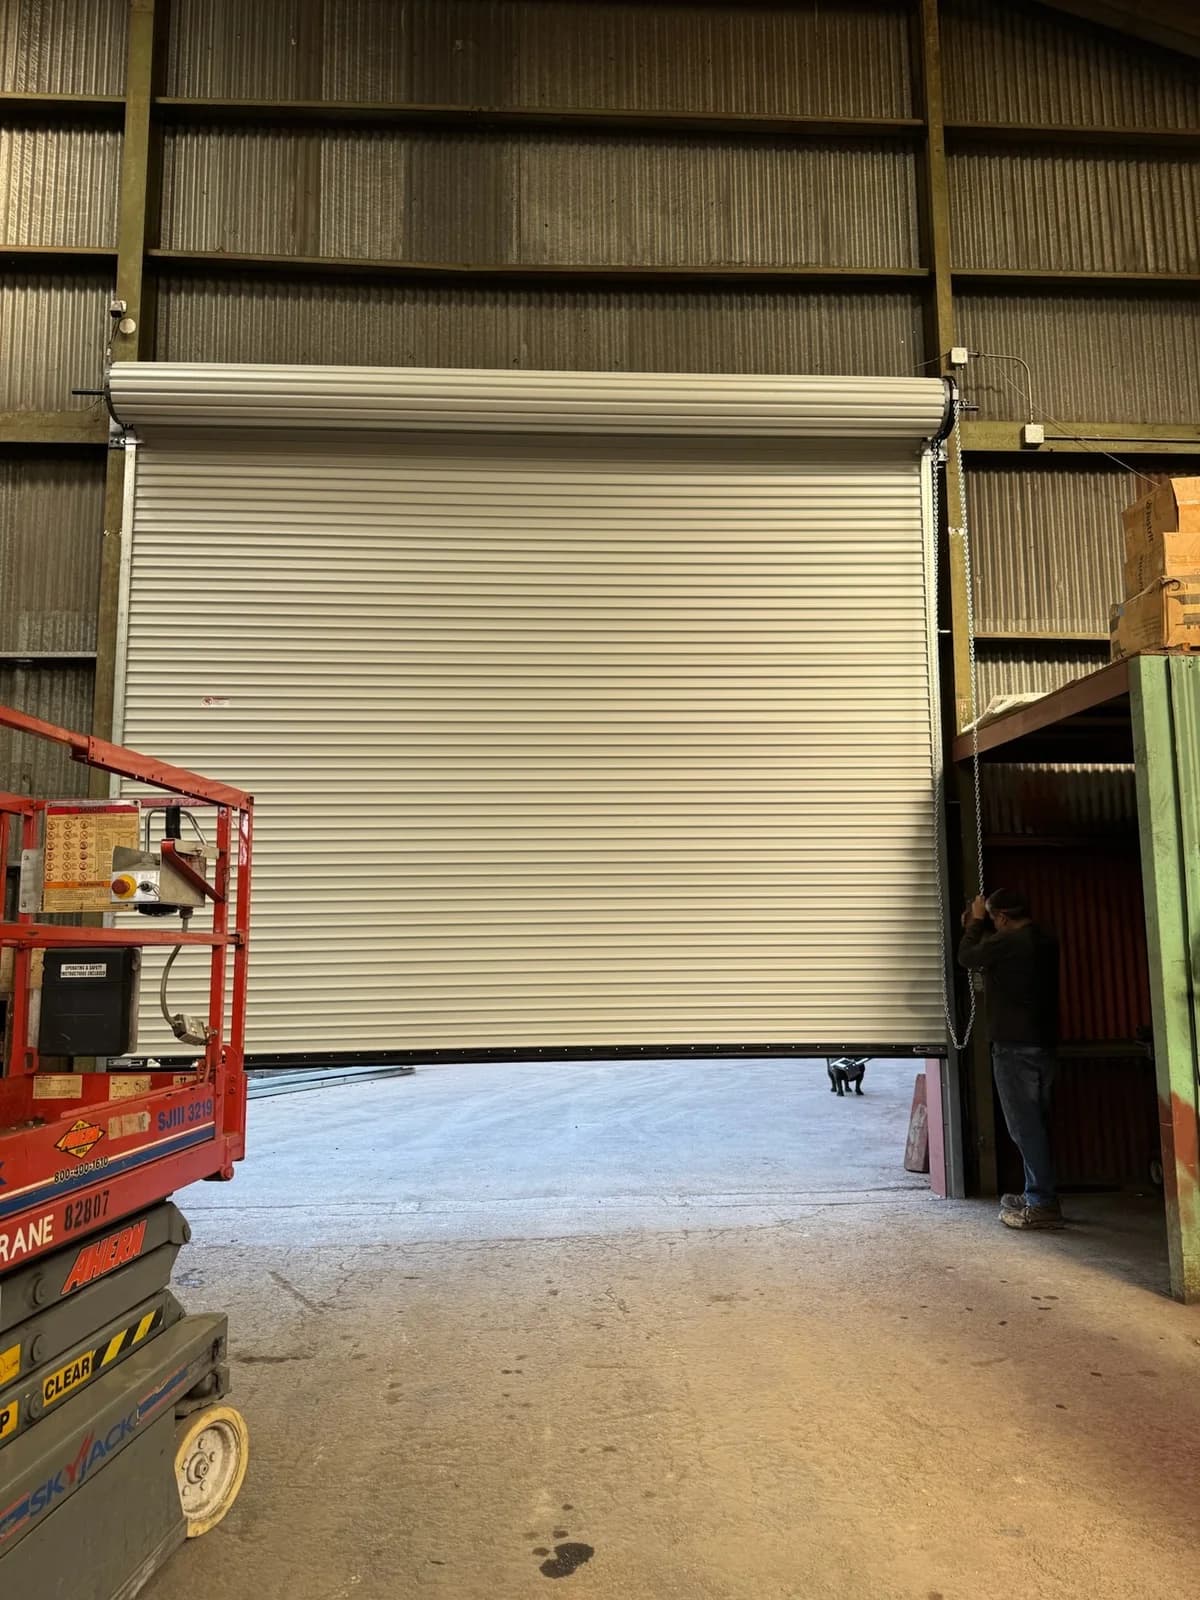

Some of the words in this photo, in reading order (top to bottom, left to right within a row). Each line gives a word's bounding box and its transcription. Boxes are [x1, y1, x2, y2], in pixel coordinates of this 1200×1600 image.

[188, 1098, 213, 1122] 3219
[54, 1156, 109, 1184] 800-400-1610
[64, 1190, 110, 1231] 82807
[61, 1219, 147, 1295] AHERN
[44, 1356, 90, 1401] CLEAR
[28, 1412, 135, 1517] SKYJACK
